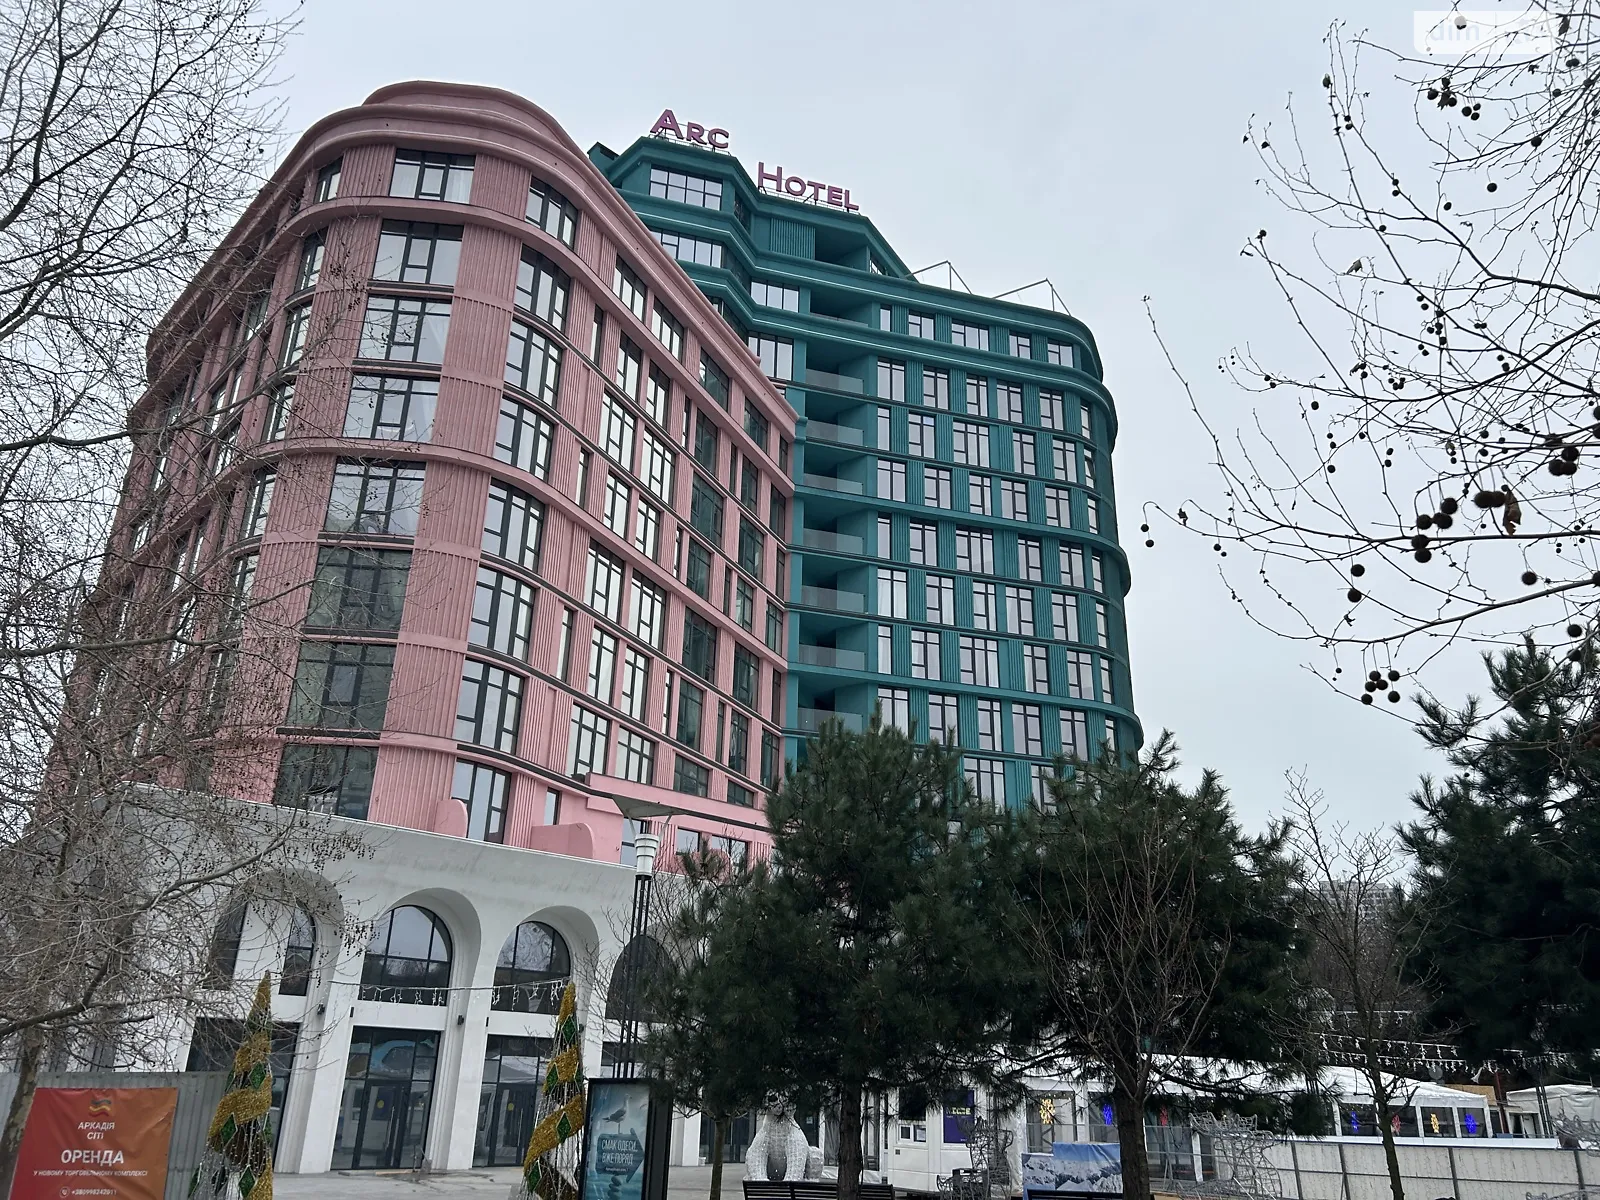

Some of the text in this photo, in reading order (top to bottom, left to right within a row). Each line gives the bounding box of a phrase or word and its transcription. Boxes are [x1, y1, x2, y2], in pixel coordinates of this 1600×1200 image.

[78, 1122, 115, 1131] АРКАДІЯ
[87, 1132, 104, 1140] СІТІ
[61, 1149, 124, 1167] ОРЕНДА
